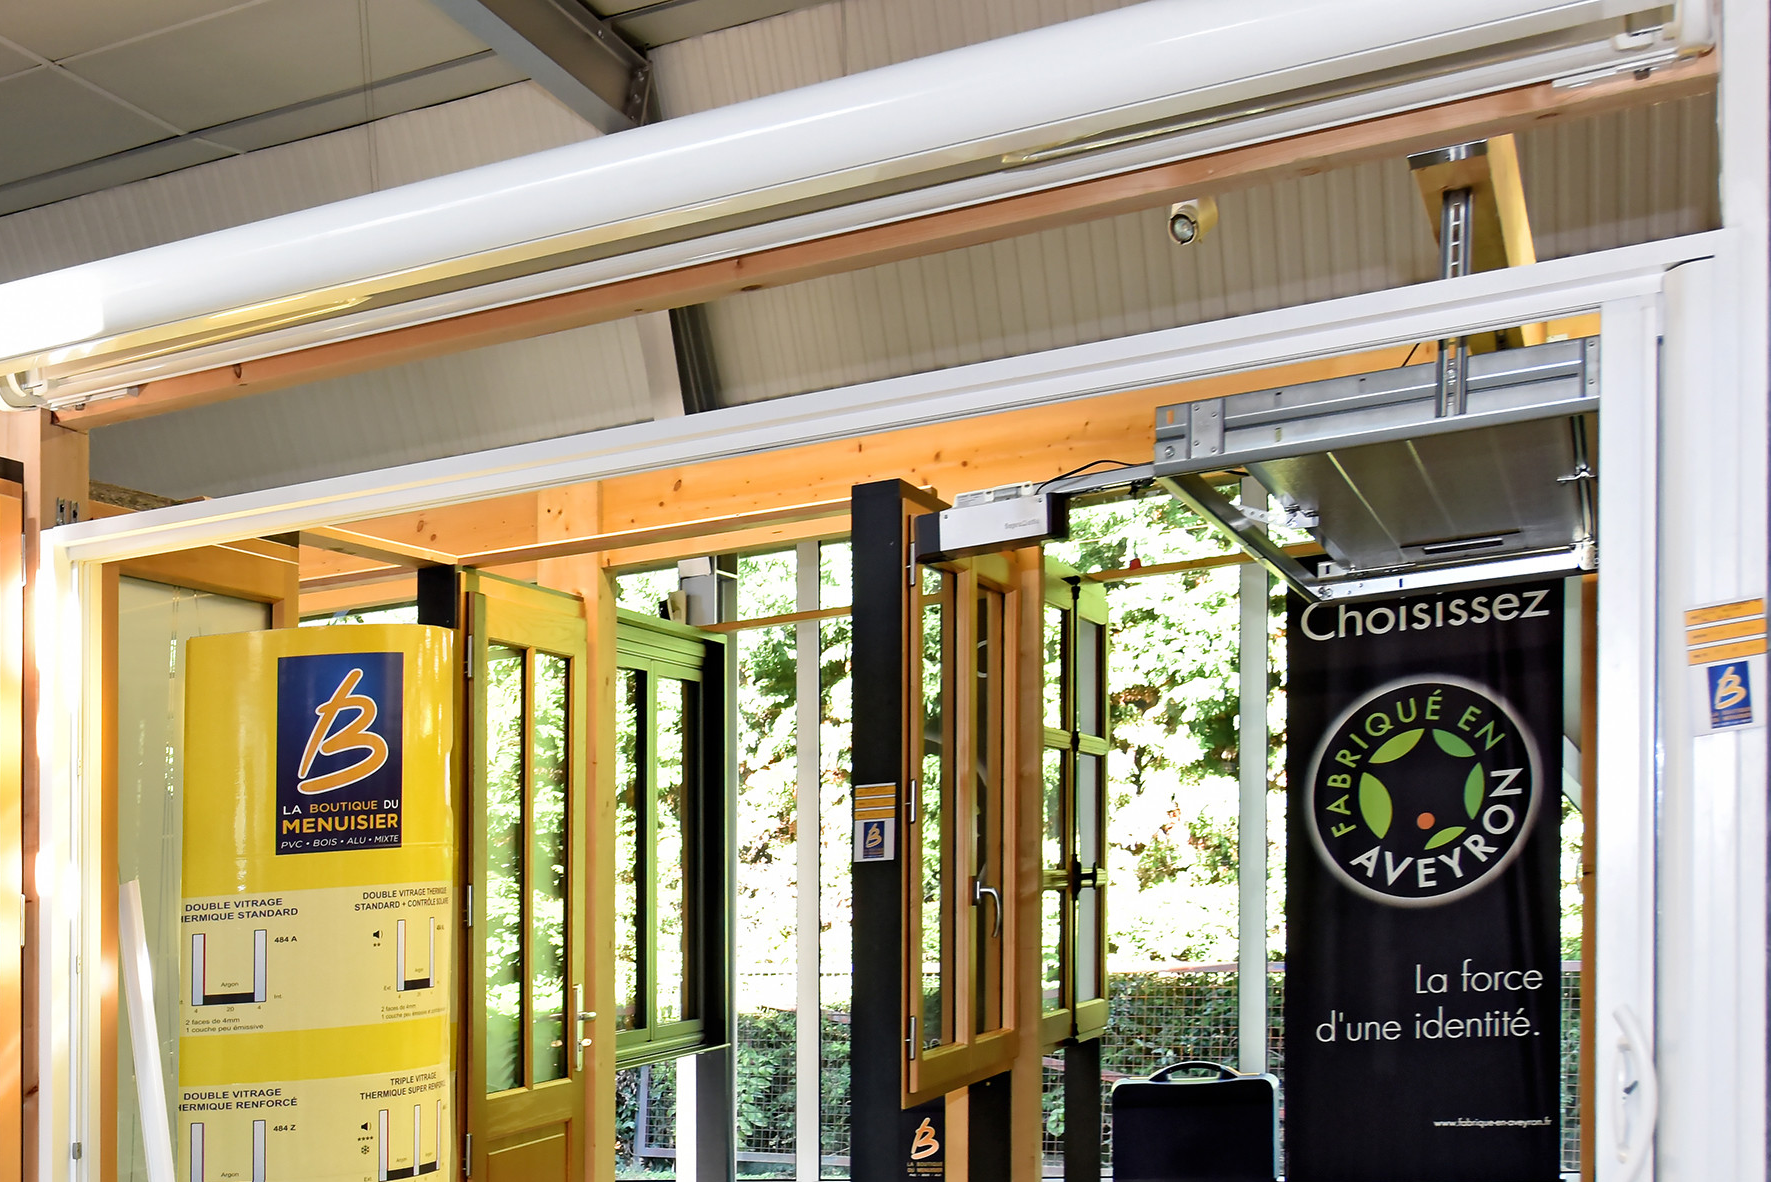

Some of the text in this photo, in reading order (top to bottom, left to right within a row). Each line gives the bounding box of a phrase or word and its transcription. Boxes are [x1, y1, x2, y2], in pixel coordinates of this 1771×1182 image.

[1301, 590, 1550, 641] Choisissez
[297, 668, 389, 794] B
[1326, 689, 1506, 838] FABRIQUÉ EN
[283, 799, 399, 815] LA BOUTIQUE DU
[283, 814, 398, 834] MENUISIER
[1350, 767, 1523, 888] AVEYRON
[281, 834, 399, 849] PVC BOIS ALU MIXTE
[363, 890, 397, 899] DOUBLE
[399, 888, 425, 897] VITRAGE
[186, 898, 282, 912] DOUBLE VITRAGE
[355, 901, 400, 911] STANDARD
[238, 908, 298, 919] STANDARD
[1416, 959, 1543, 994] La force
[1316, 1006, 1540, 1042] d'une identité.
[390, 1072, 436, 1085] TRIPLE VITRAGE
[184, 1088, 281, 1100] DOUBLE VITRAGE
[360, 1088, 406, 1100] THERMIQUE
[408, 1085, 427, 1094] SUPER
[179, 1097, 297, 1111] HERMIQUE RENFORCÉ
[911, 1117, 939, 1160] B
